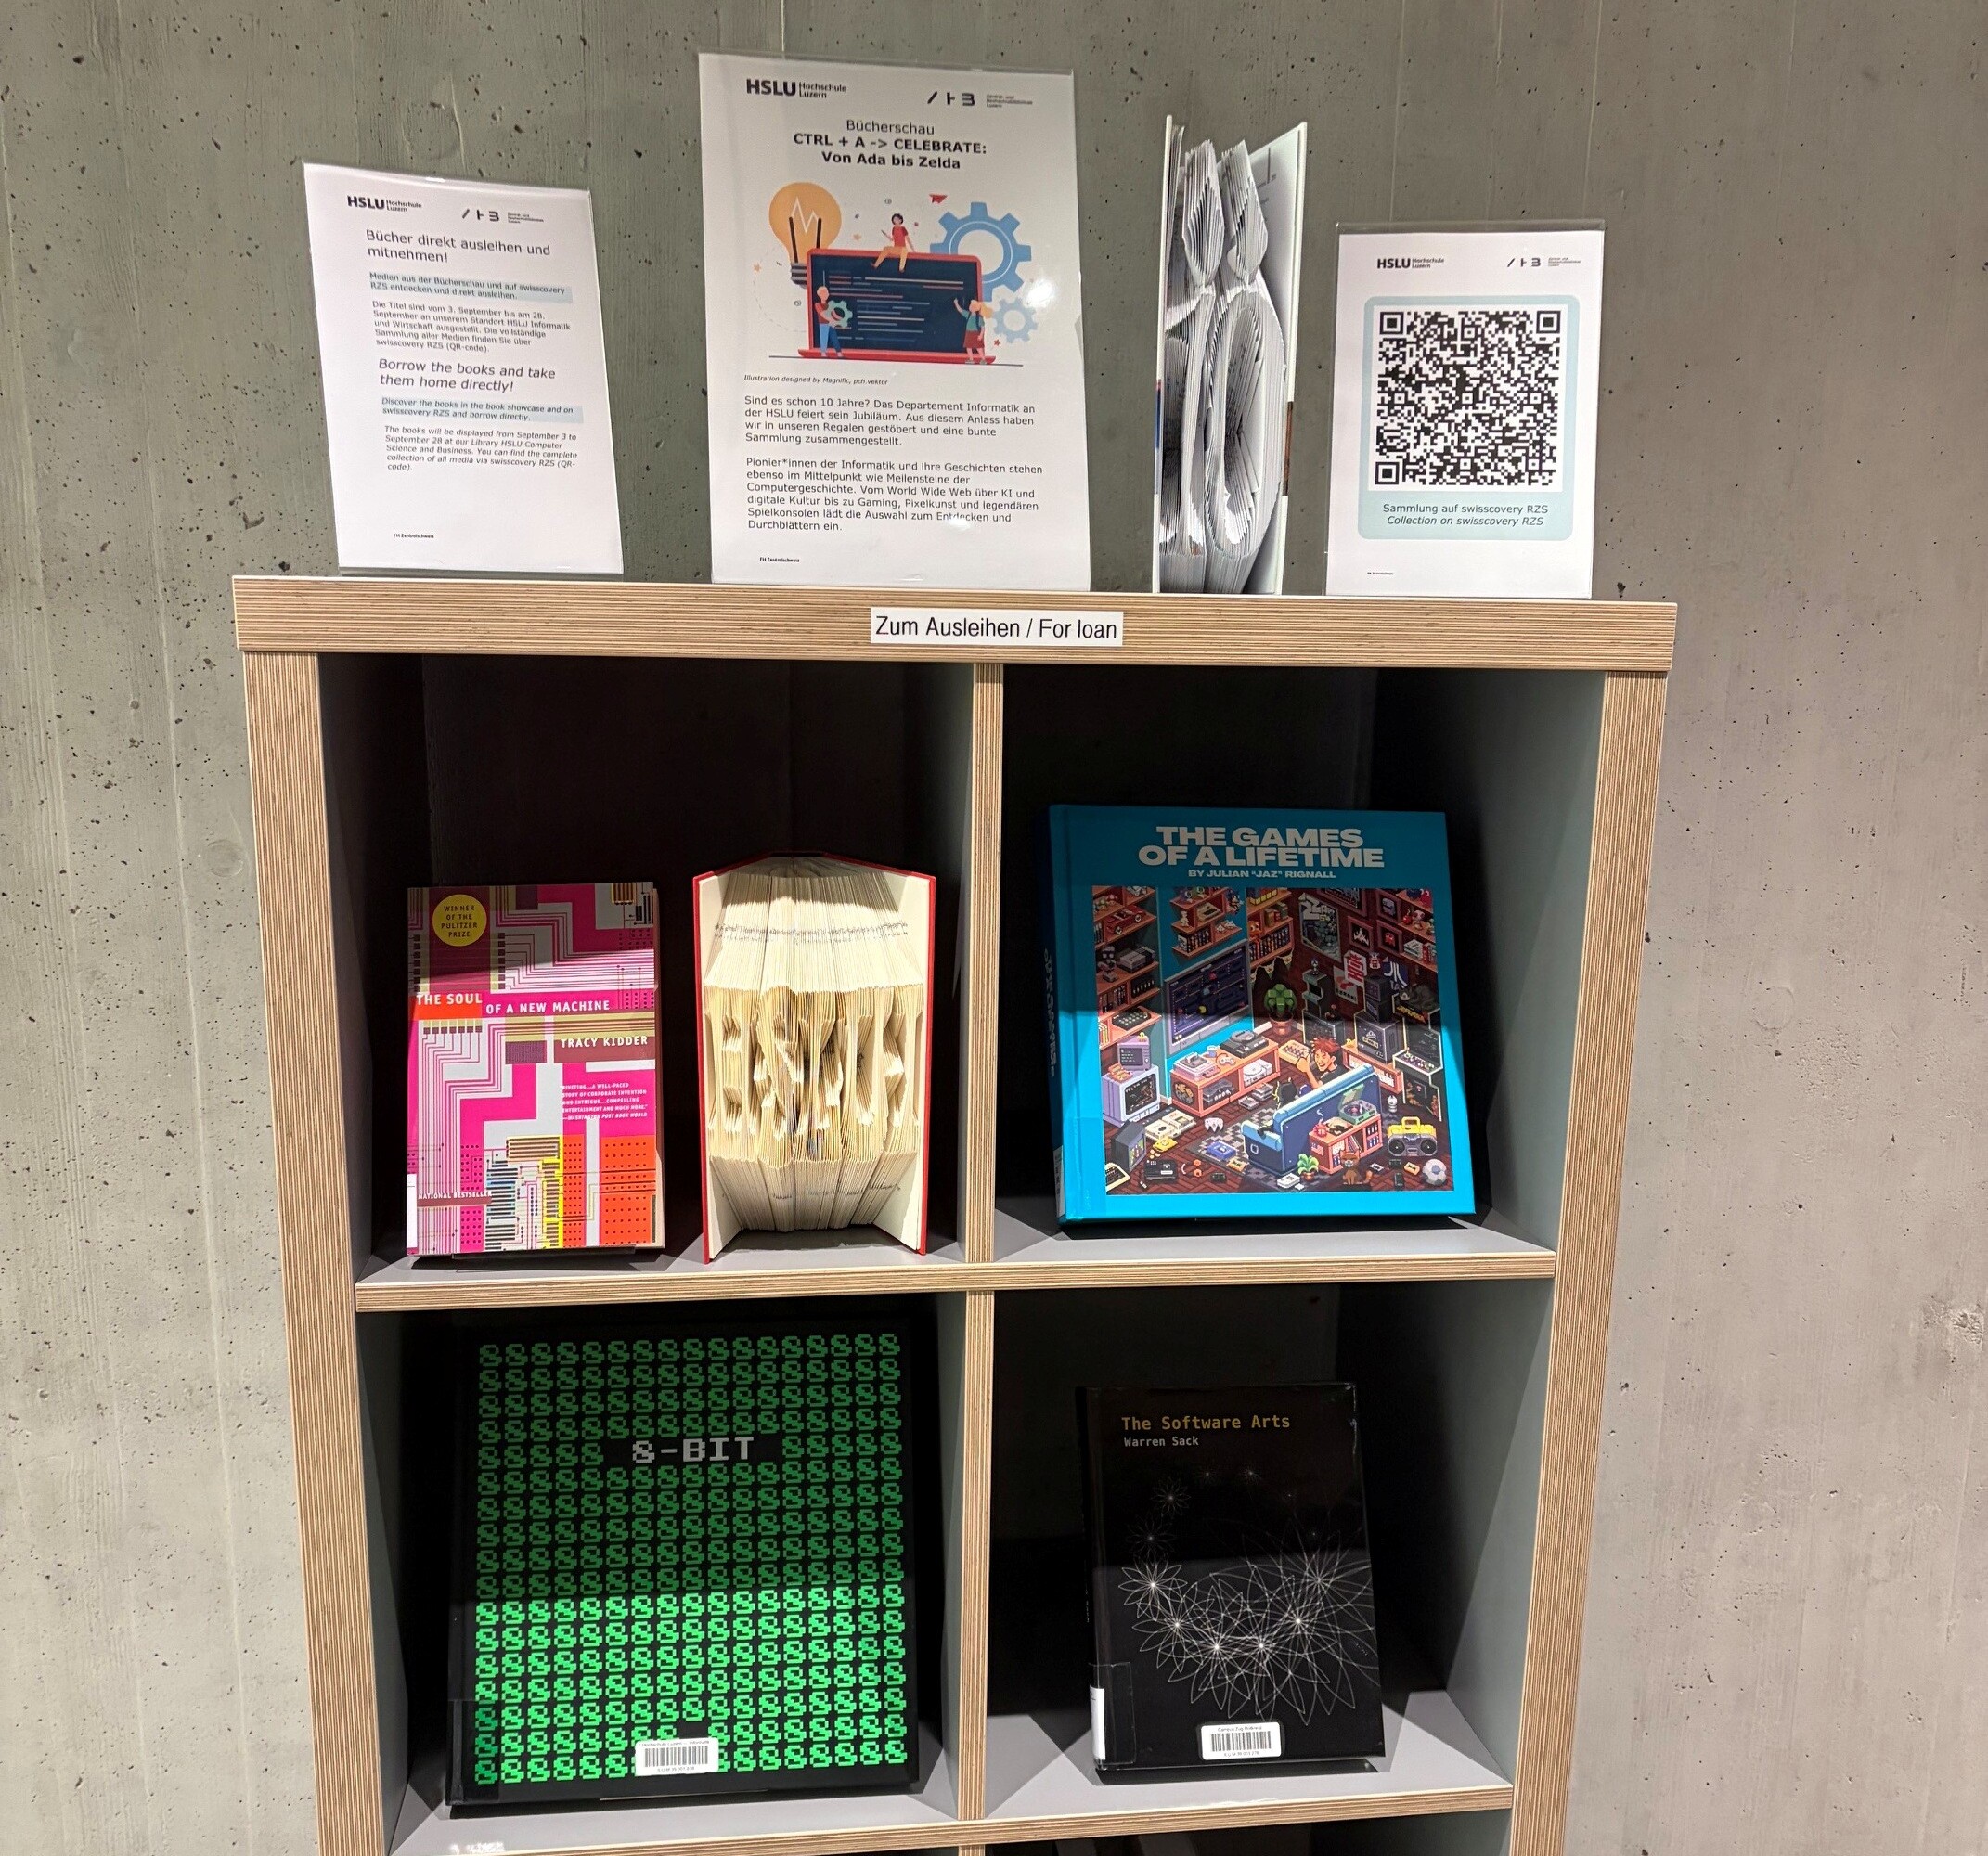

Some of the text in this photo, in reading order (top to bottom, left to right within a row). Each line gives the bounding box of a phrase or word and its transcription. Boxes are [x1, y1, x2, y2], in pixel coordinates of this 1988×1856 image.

[746, 78, 846, 96] HSLU Hochschule
[799, 90, 827, 98] Luzern
[846, 119, 934, 135] Bücherschau
[794, 133, 986, 153] CTRL + A -> CELEBRATE:
[821, 151, 960, 169] Von Ada bis Zelda
[347, 196, 384, 209] HSLU
[366, 229, 549, 255] Bücher direkt ausleihen und
[368, 247, 447, 262] mitnehmen!
[1376, 257, 1410, 268] HSLU
[379, 358, 555, 379] Borrow the books and take
[380, 375, 513, 393] them home directly!
[744, 395, 767, 405] Sind
[786, 397, 816, 406] schon
[820, 397, 833, 406] 10
[836, 398, 870, 407] Jahre?
[873, 399, 893, 408] Das
[897, 400, 963, 411] Departement
[967, 402, 1019, 412] Informatik
[744, 407, 1033, 425] der HSLU feiert sein Jubiläum. Aus diesem Anlass haben
[744, 420, 996, 436] wir in unseren Regalen gestöbert und eine bunte
[745, 432, 901, 446] Sammlung zusammengestellt.
[820, 459, 837, 468] der
[841, 459, 897, 470] Informatik
[898, 461, 918, 470] und
[921, 461, 941, 471] ihre
[944, 462, 1005, 472] Geschichten
[1009, 464, 1042, 473] stehen
[746, 470, 970, 484] ebenso im Mittelpunkt wie Meilensteine der
[747, 483, 1034, 497] Computergeschichte. Vom World Wide Web über KI und
[747, 495, 785, 506] digitale
[789, 496, 820, 505] Kultur
[824, 496, 839, 506] bis
[858, 497, 900, 509] Gaming,
[905, 498, 956, 509] Pixelkunst
[960, 500, 978, 509] und
[983, 500, 1038, 511] legendären
[1383, 503, 1548, 514] Sammlung auf swisscovery RZS
[747, 507, 819, 517] Spielkonsolen
[823, 509, 843, 518] lädt
[846, 509, 861, 519] die
[865, 509, 907, 520] Auswahl
[992, 513, 1011, 522] und
[1387, 515, 1437, 524] Collection
[1456, 517, 1518, 526] swisscovery
[1521, 516, 1543, 525] RZS
[748, 520, 842, 530] Durchblättern ein.
[875, 615, 1116, 638] Zum Ausleihen / For loan
[1155, 826, 1362, 848] THE GAMES
[1138, 845, 1383, 867] OF A LIFETIME
[444, 904, 474, 912] WINNER
[445, 913, 457, 922] OF
[416, 993, 482, 1005] THE SOUL
[485, 1000, 609, 1014] OF A NEW MACHINE
[560, 1035, 648, 1049] TRACY KIDDER
[418, 1192, 451, 1200] NATIONAL
[1121, 1414, 1289, 1430] The Software Arts
[1124, 1436, 1198, 1446] Warren Sack
